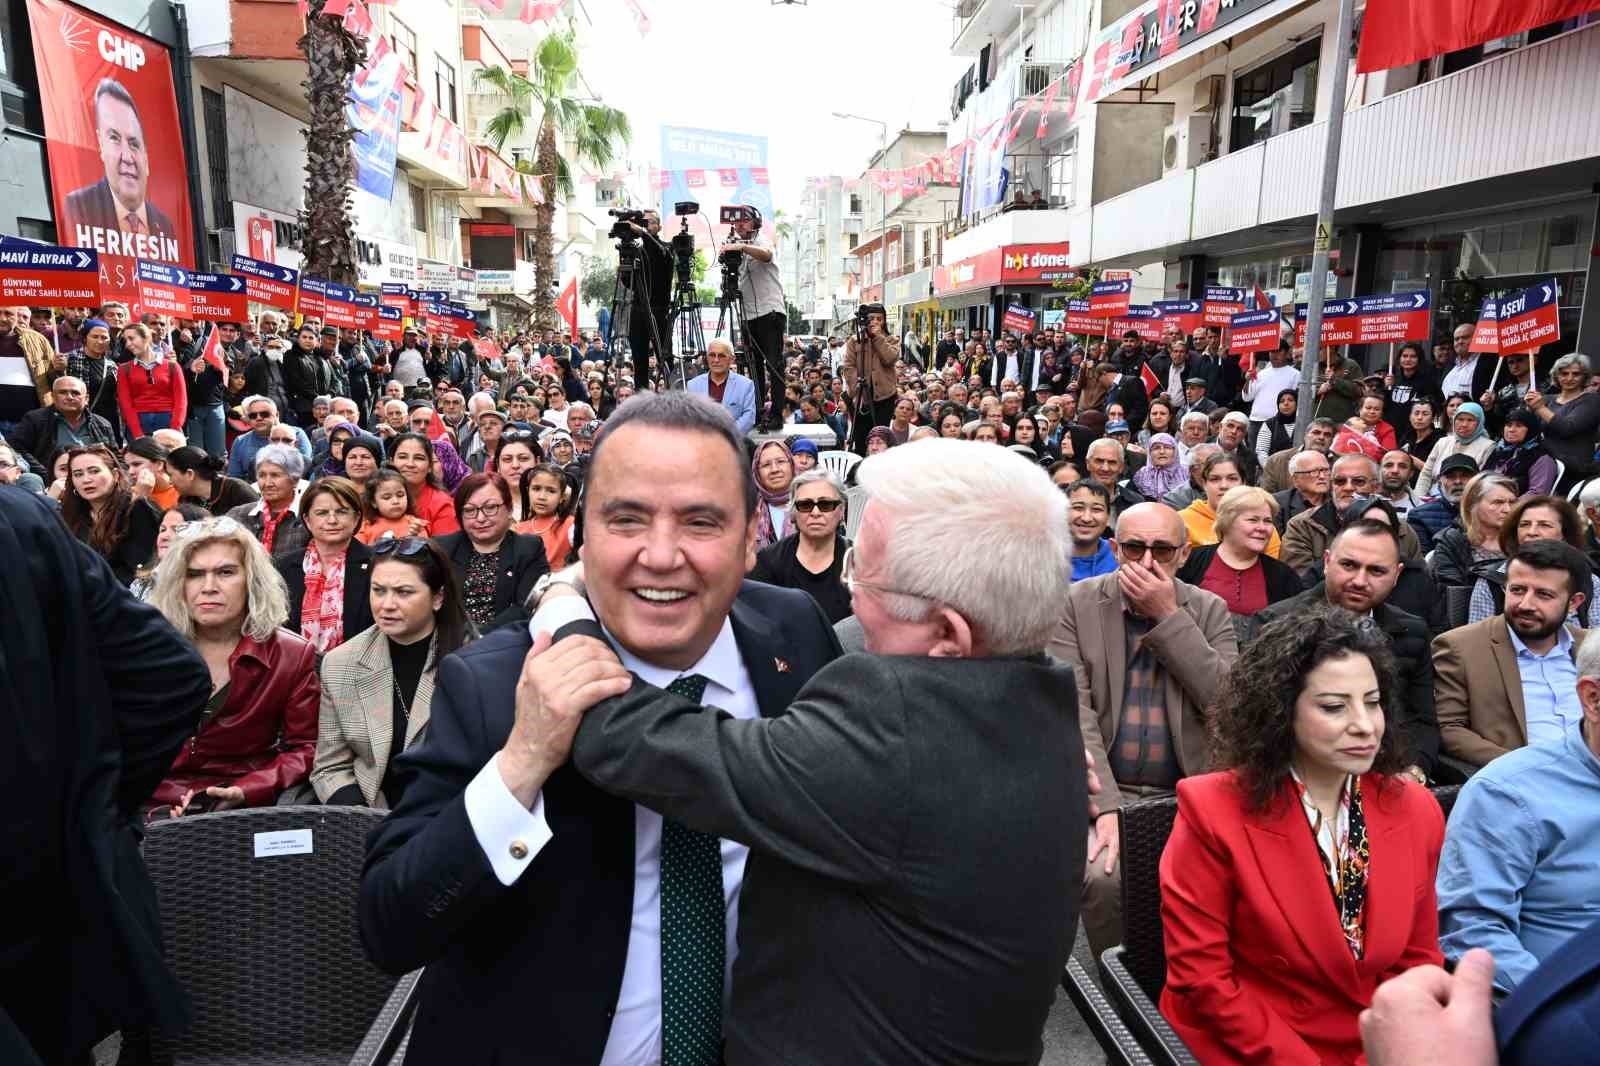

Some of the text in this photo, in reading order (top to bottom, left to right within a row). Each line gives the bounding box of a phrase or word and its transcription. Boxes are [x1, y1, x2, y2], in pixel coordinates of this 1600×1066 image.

[1147, 0, 1197, 56] ALER
[97, 30, 146, 72] CHP
[76, 223, 180, 263] HERKESİN
[1, 251, 73, 265] MAVİ BAYRAK
[4, 288, 14, 297] EN
[15, 288, 37, 297] TEMİZ
[1500, 294, 1526, 319] AŞEVİ
[1519, 318, 1537, 333] ÇOCUK
